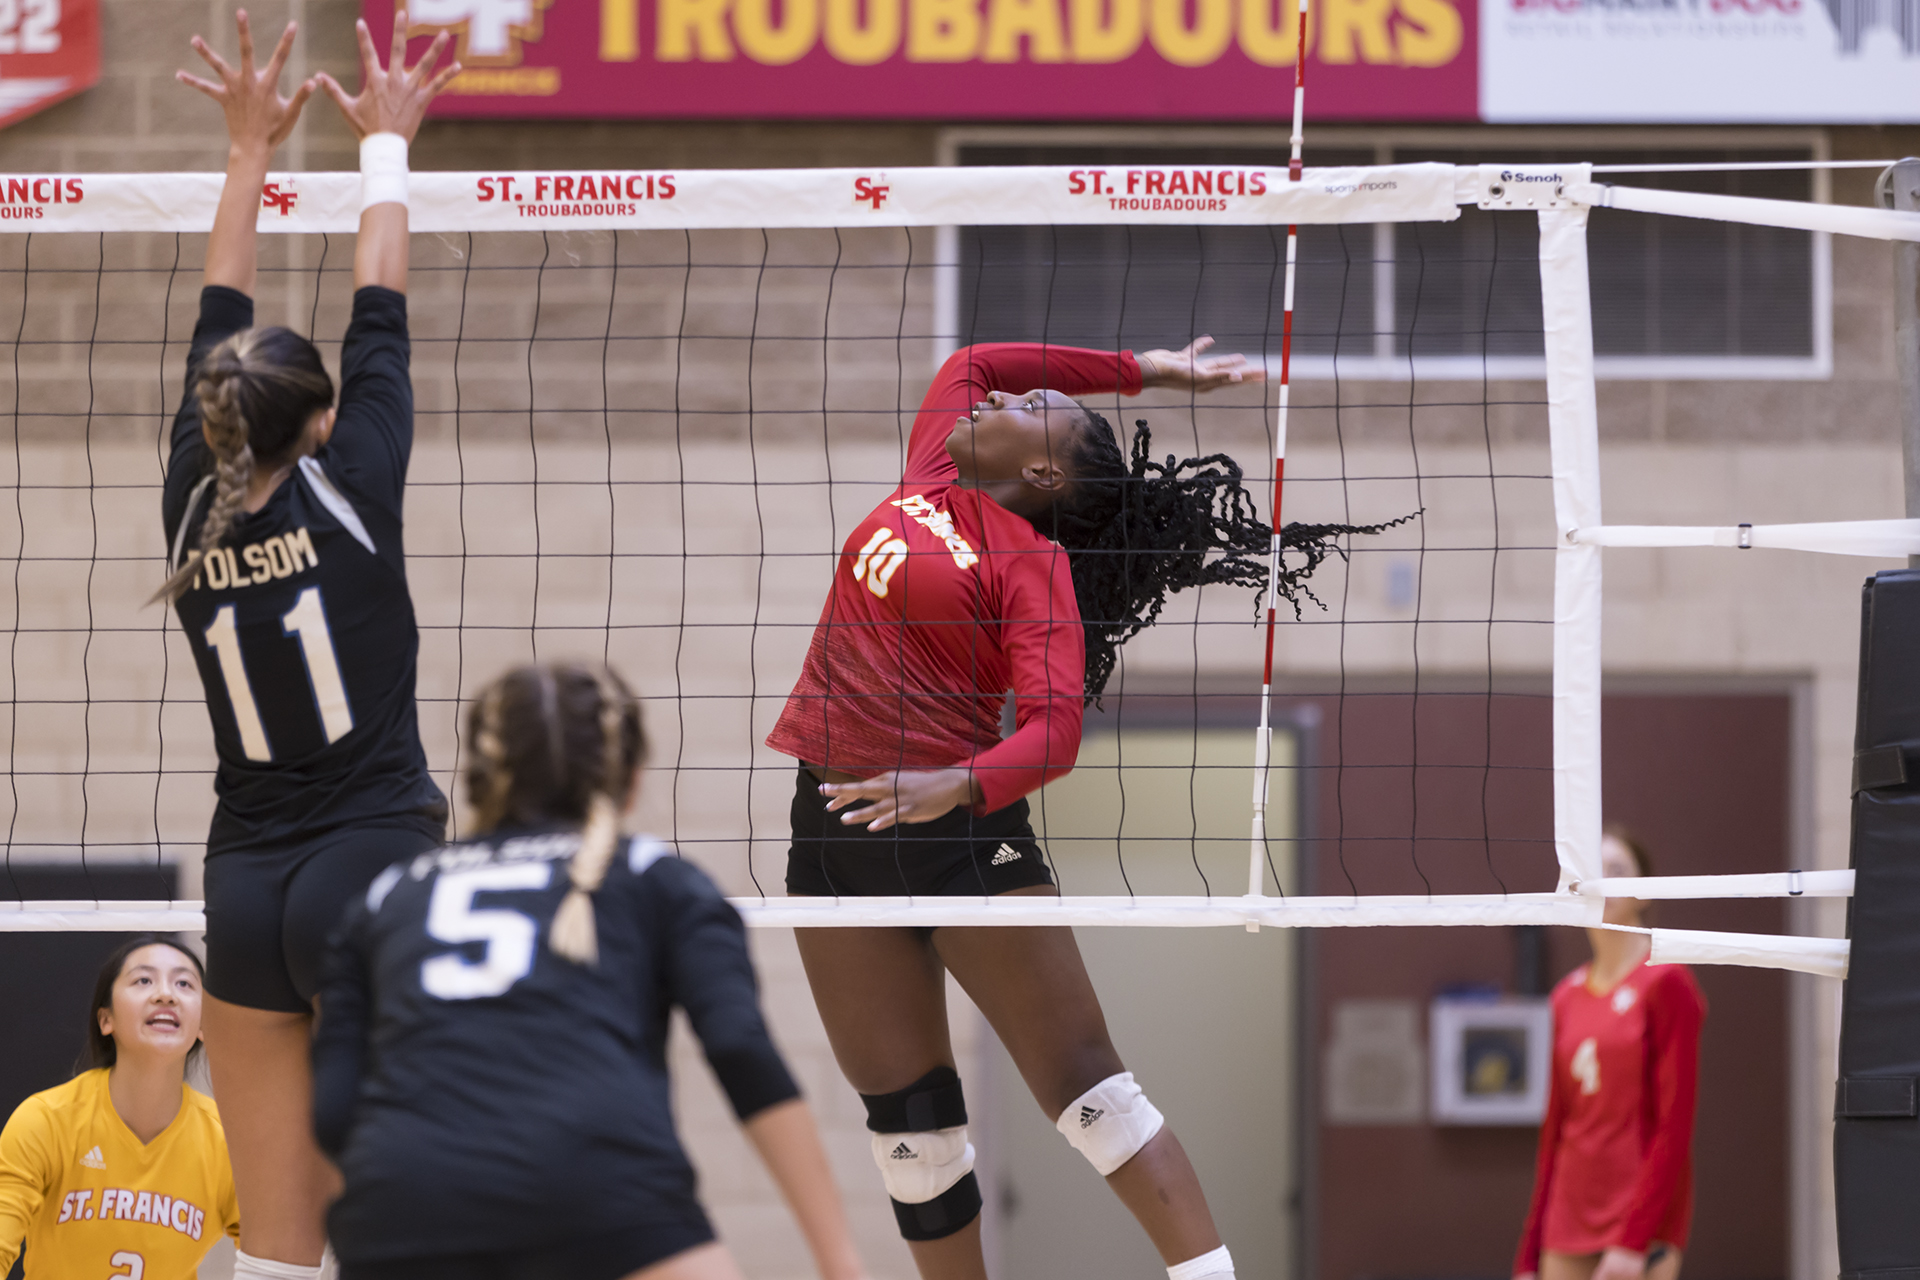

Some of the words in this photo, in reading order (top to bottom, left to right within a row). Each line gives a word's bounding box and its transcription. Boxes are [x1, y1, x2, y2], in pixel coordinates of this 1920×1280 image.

[0, 177, 84, 204] NCIS
[476, 176, 524, 202] ST.
[535, 175, 676, 201] FRANCIS
[1069, 170, 1114, 195] ST.
[1126, 170, 1267, 196] FRANCIS
[1514, 172, 1563, 183] Senoh
[518, 203, 636, 217] TROUBADOURS
[1109, 198, 1227, 211] TROUBADOURS
[852, 527, 910, 599] 10
[204, 584, 355, 763] 11
[991, 851, 1022, 866] adidas
[420, 860, 552, 1000] 5
[1081, 1109, 1105, 1129] adidas
[56, 1188, 94, 1225] ST.
[98, 1187, 206, 1242] FRANCIS
